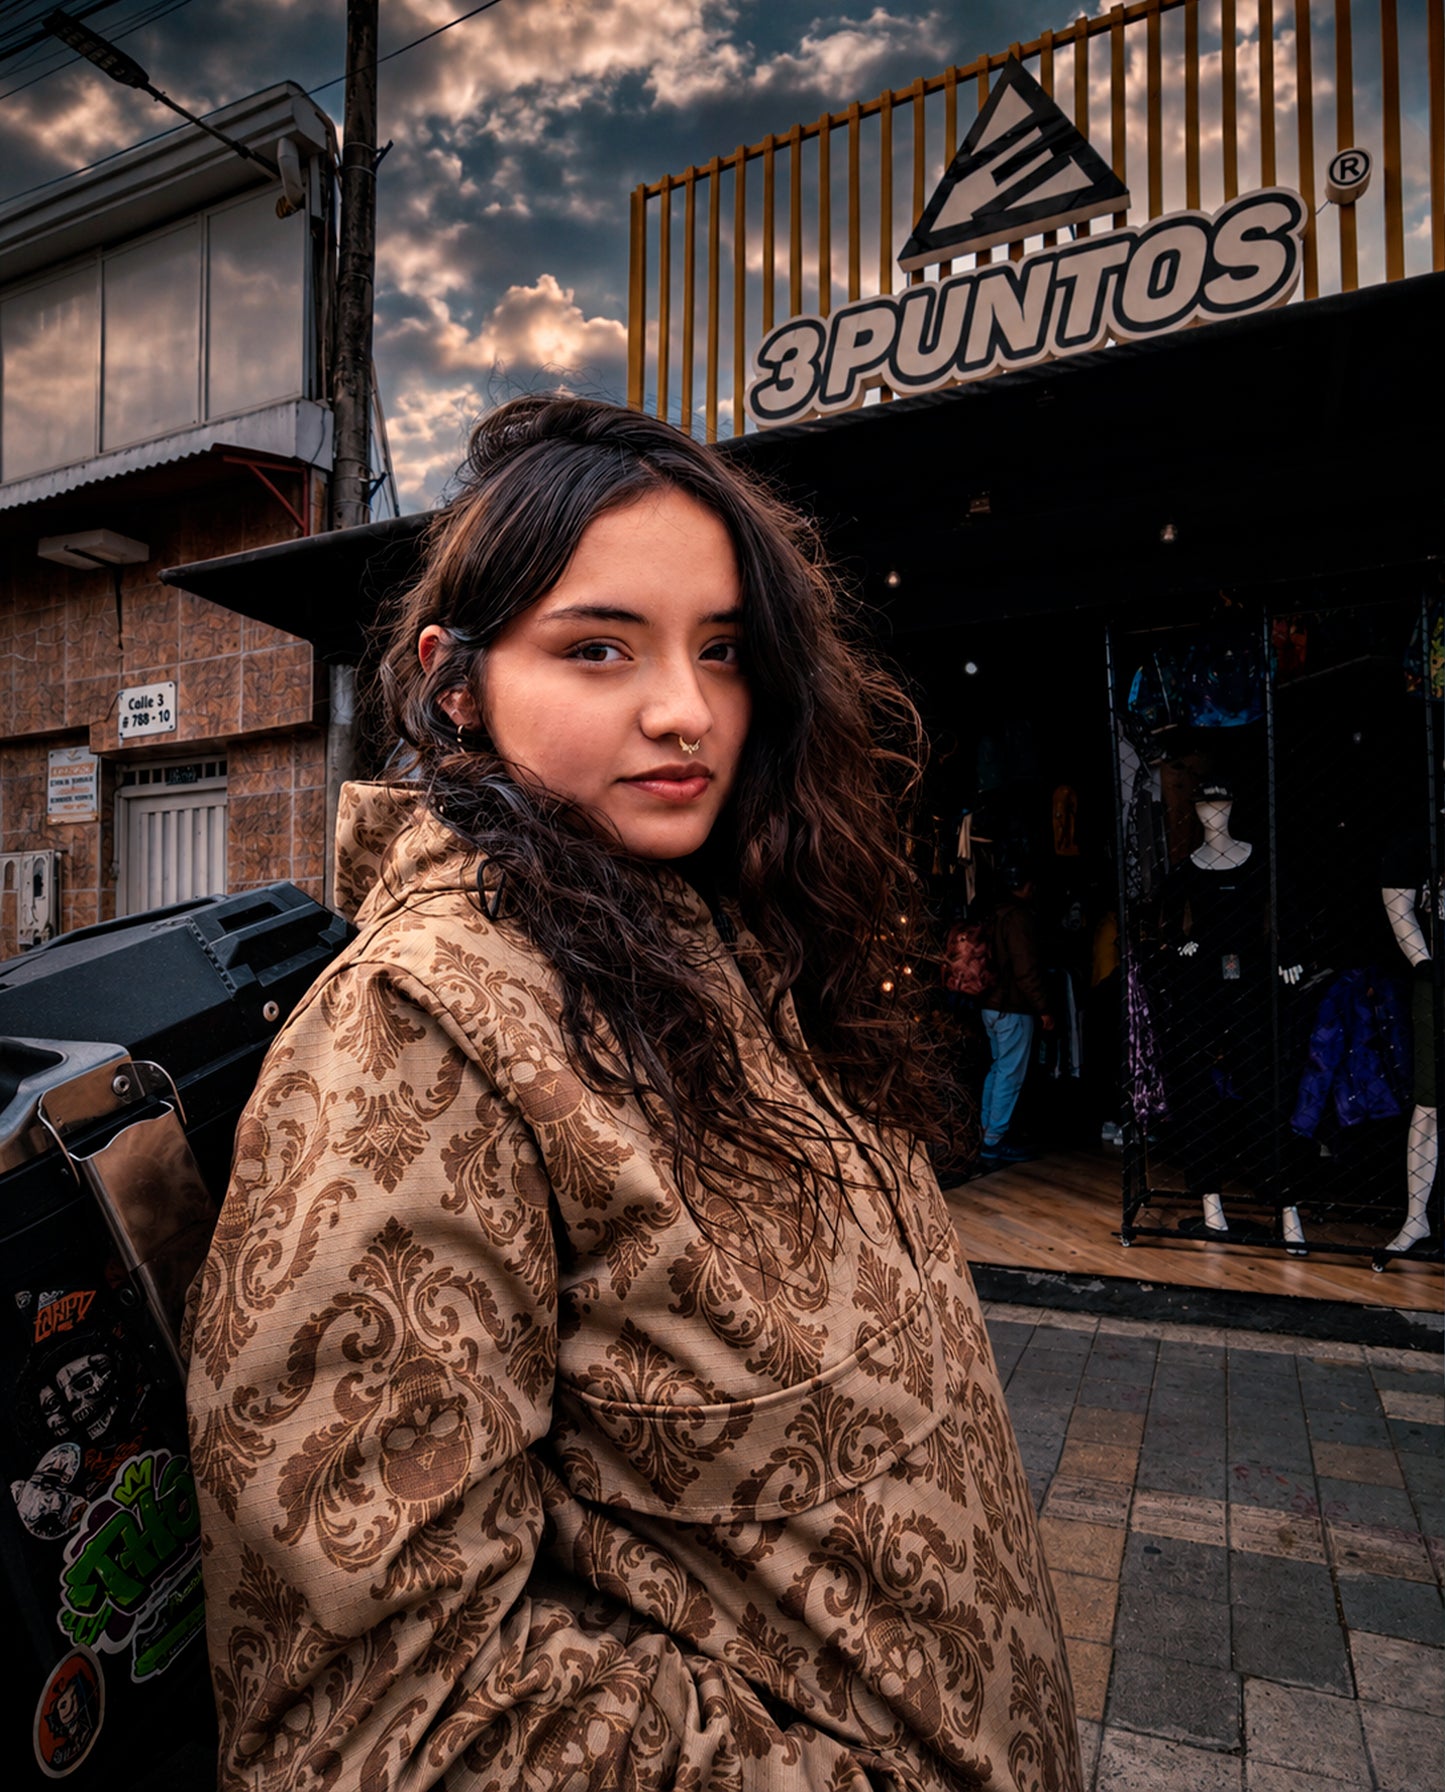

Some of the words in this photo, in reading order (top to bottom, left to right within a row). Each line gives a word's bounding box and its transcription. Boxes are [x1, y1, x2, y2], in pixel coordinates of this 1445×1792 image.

[128, 695, 154, 710] Calle
[157, 693, 164, 707] 3
[123, 716, 129, 729] #
[158, 709, 170, 723] 10
